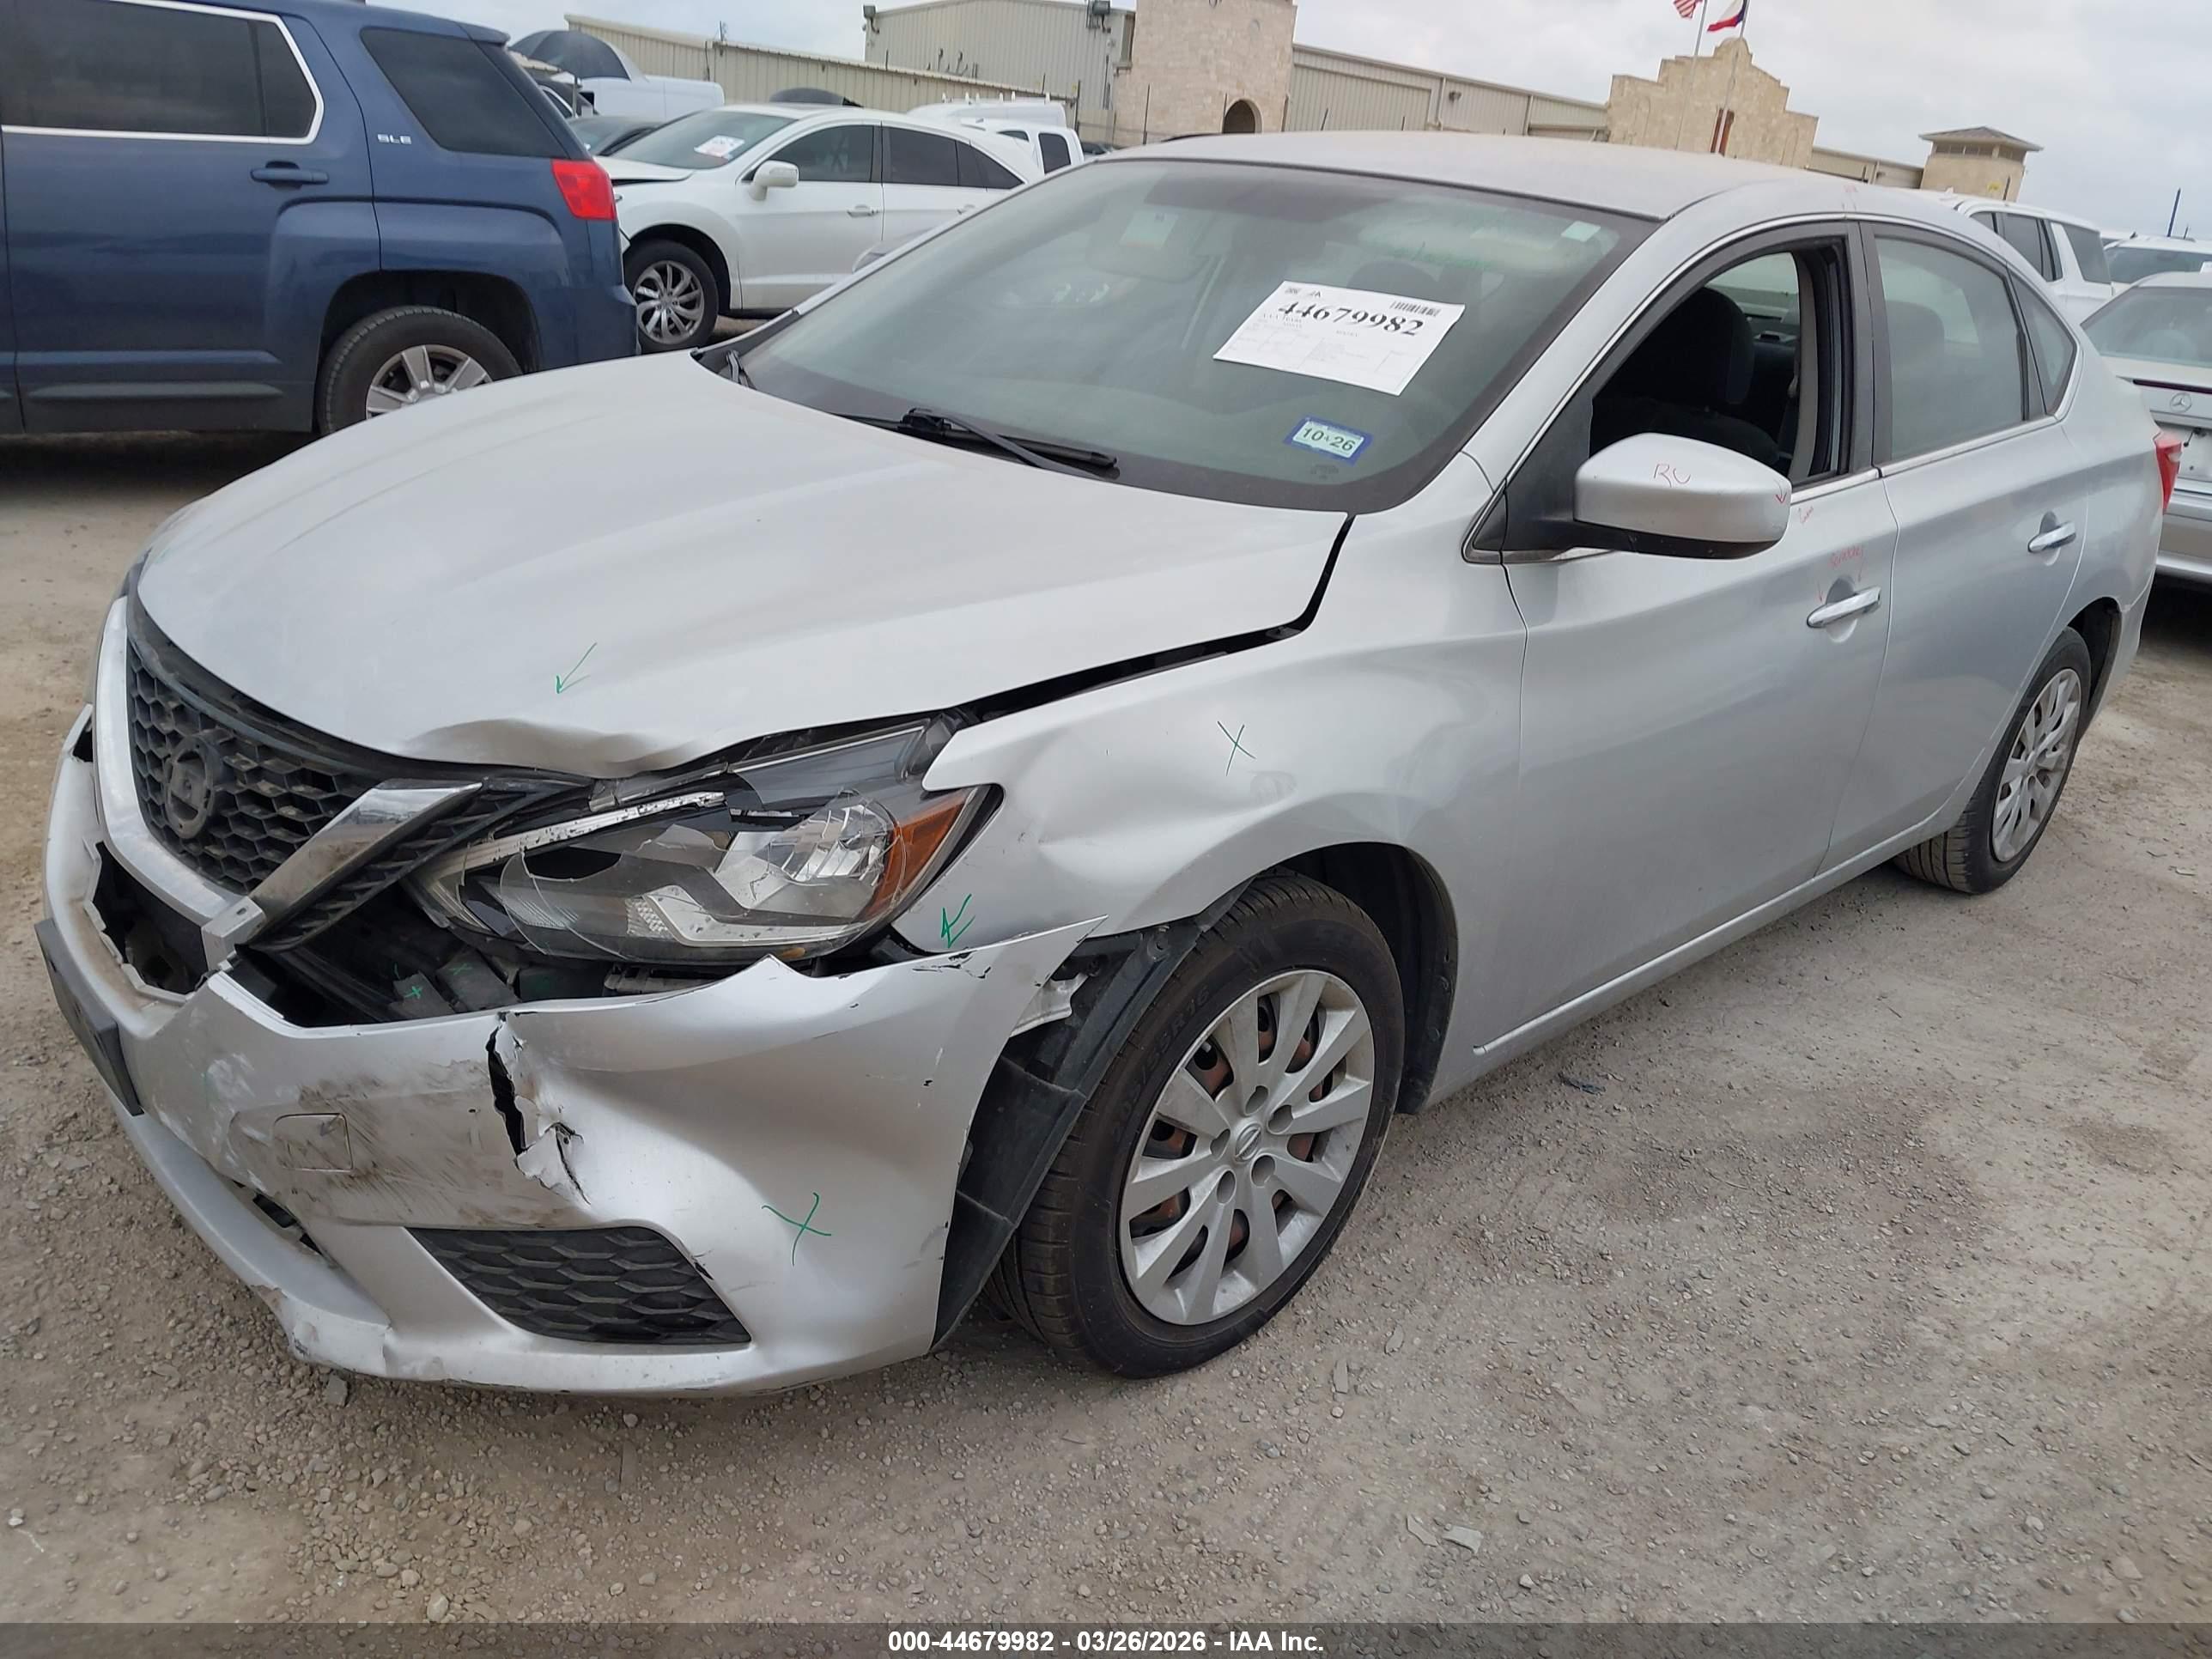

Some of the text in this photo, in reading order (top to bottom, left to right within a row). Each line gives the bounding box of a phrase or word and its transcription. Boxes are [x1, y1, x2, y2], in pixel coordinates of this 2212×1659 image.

[377, 133, 412, 145] SLE
[1278, 301, 1424, 337] 44679982
[1303, 428, 1356, 452] 10 26
